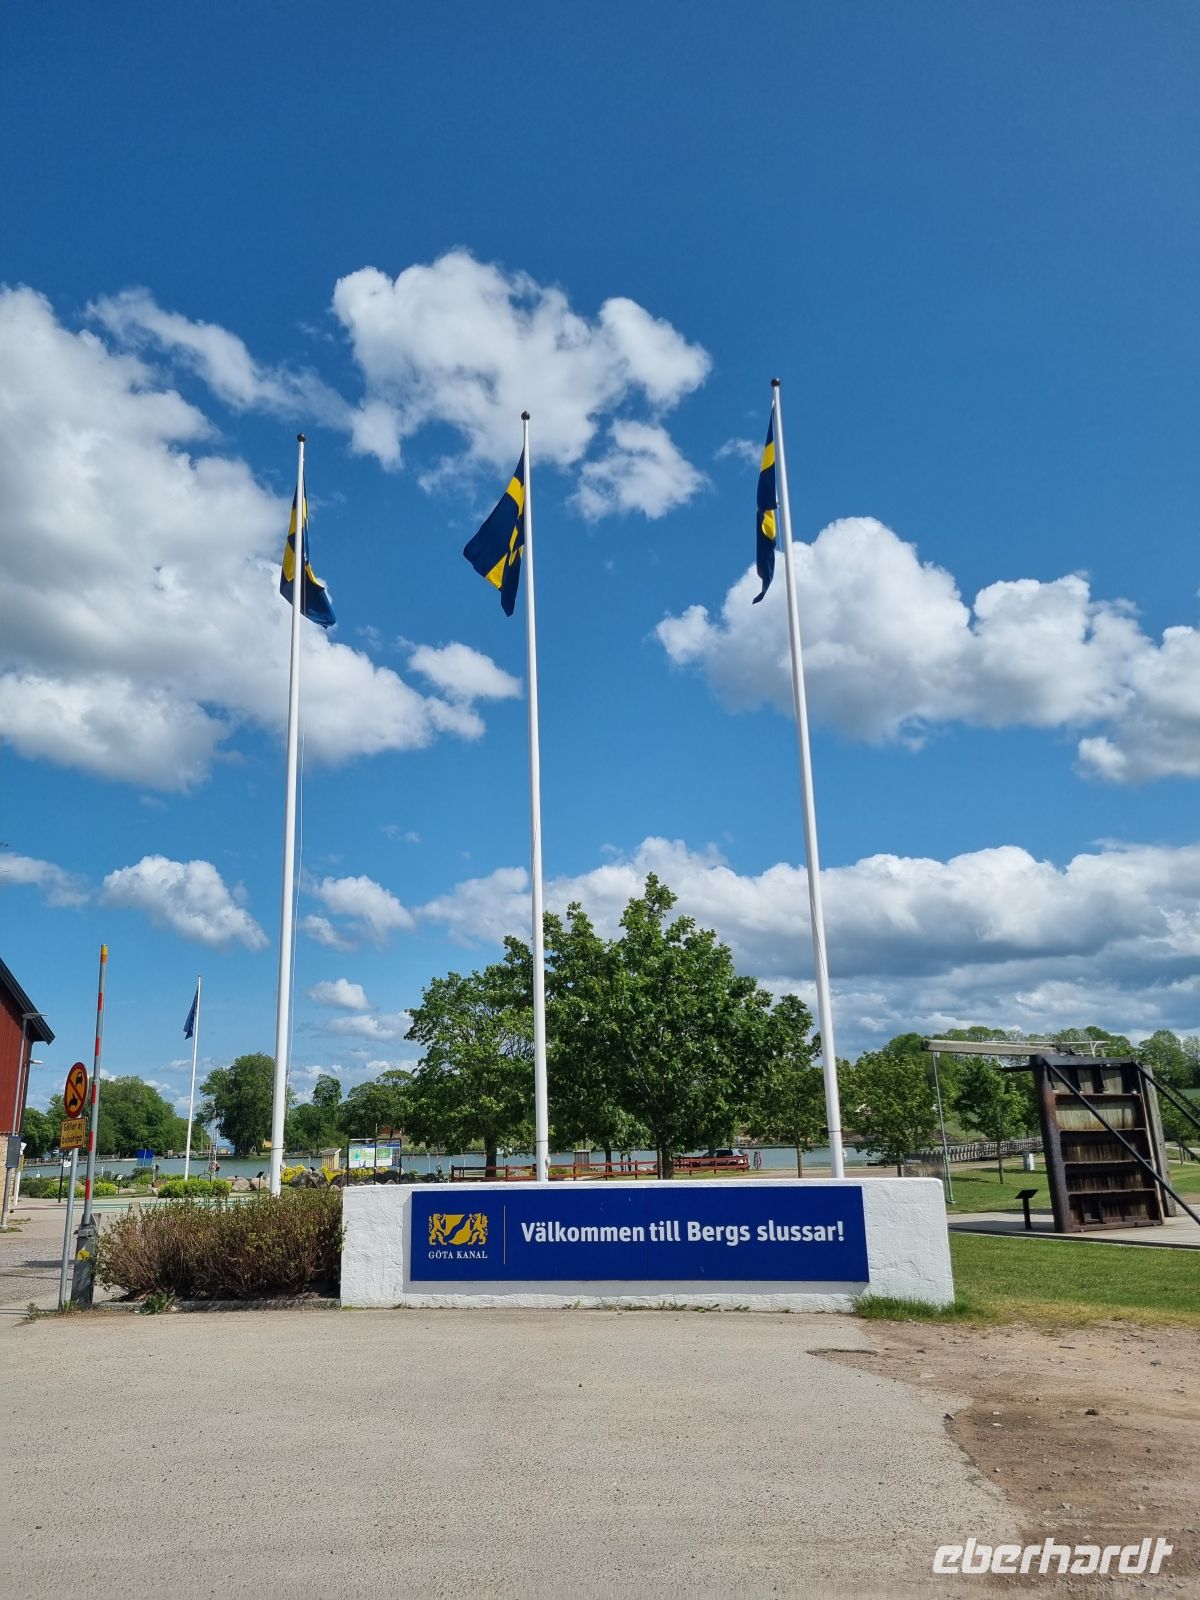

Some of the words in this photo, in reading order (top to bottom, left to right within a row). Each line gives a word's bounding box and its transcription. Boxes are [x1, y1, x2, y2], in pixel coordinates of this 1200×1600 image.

[521, 1221, 645, 1242] Välkommen
[649, 1221, 681, 1242] till
[687, 1221, 751, 1246] Bergs
[757, 1220, 845, 1242] slussar!
[428, 1250, 453, 1259] GÖTA
[456, 1250, 488, 1259] KANAL
